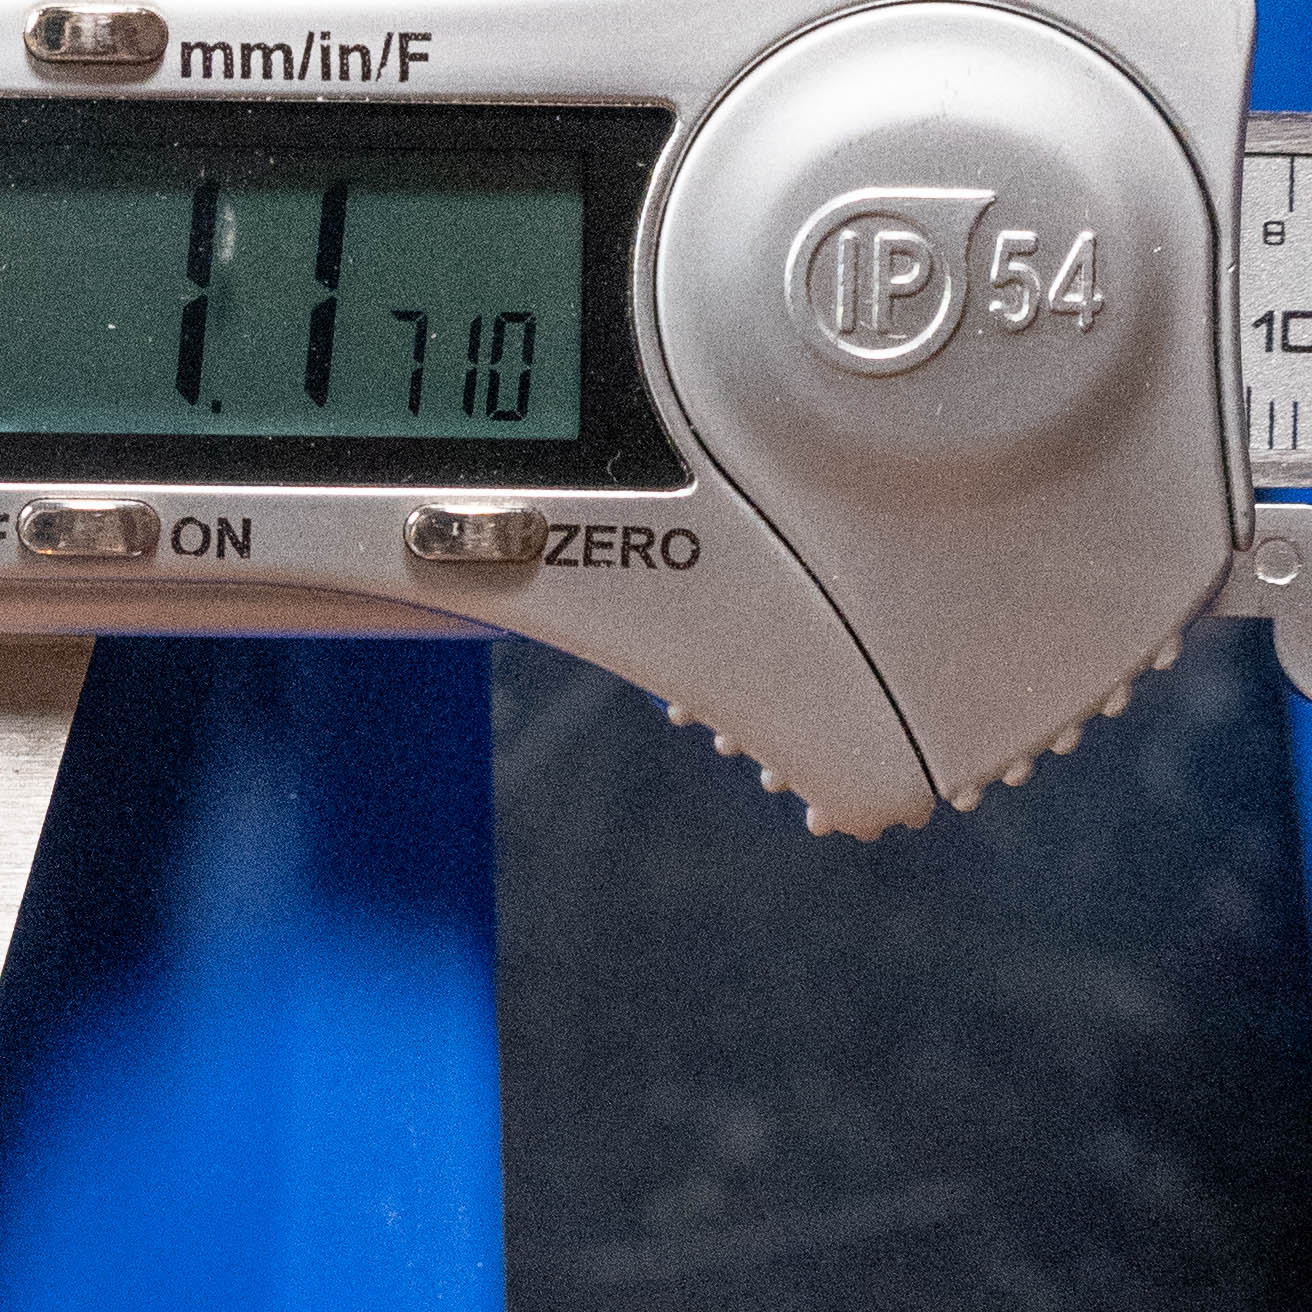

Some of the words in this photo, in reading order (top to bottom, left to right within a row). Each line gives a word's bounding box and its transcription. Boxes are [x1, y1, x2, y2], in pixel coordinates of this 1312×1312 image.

[179, 30, 433, 84] mm/in/F
[1262, 220, 1286, 247] 8
[832, 228, 928, 336] IP
[987, 229, 1106, 335] 54
[170, 515, 253, 561] ON
[542, 522, 702, 572] ZERO
